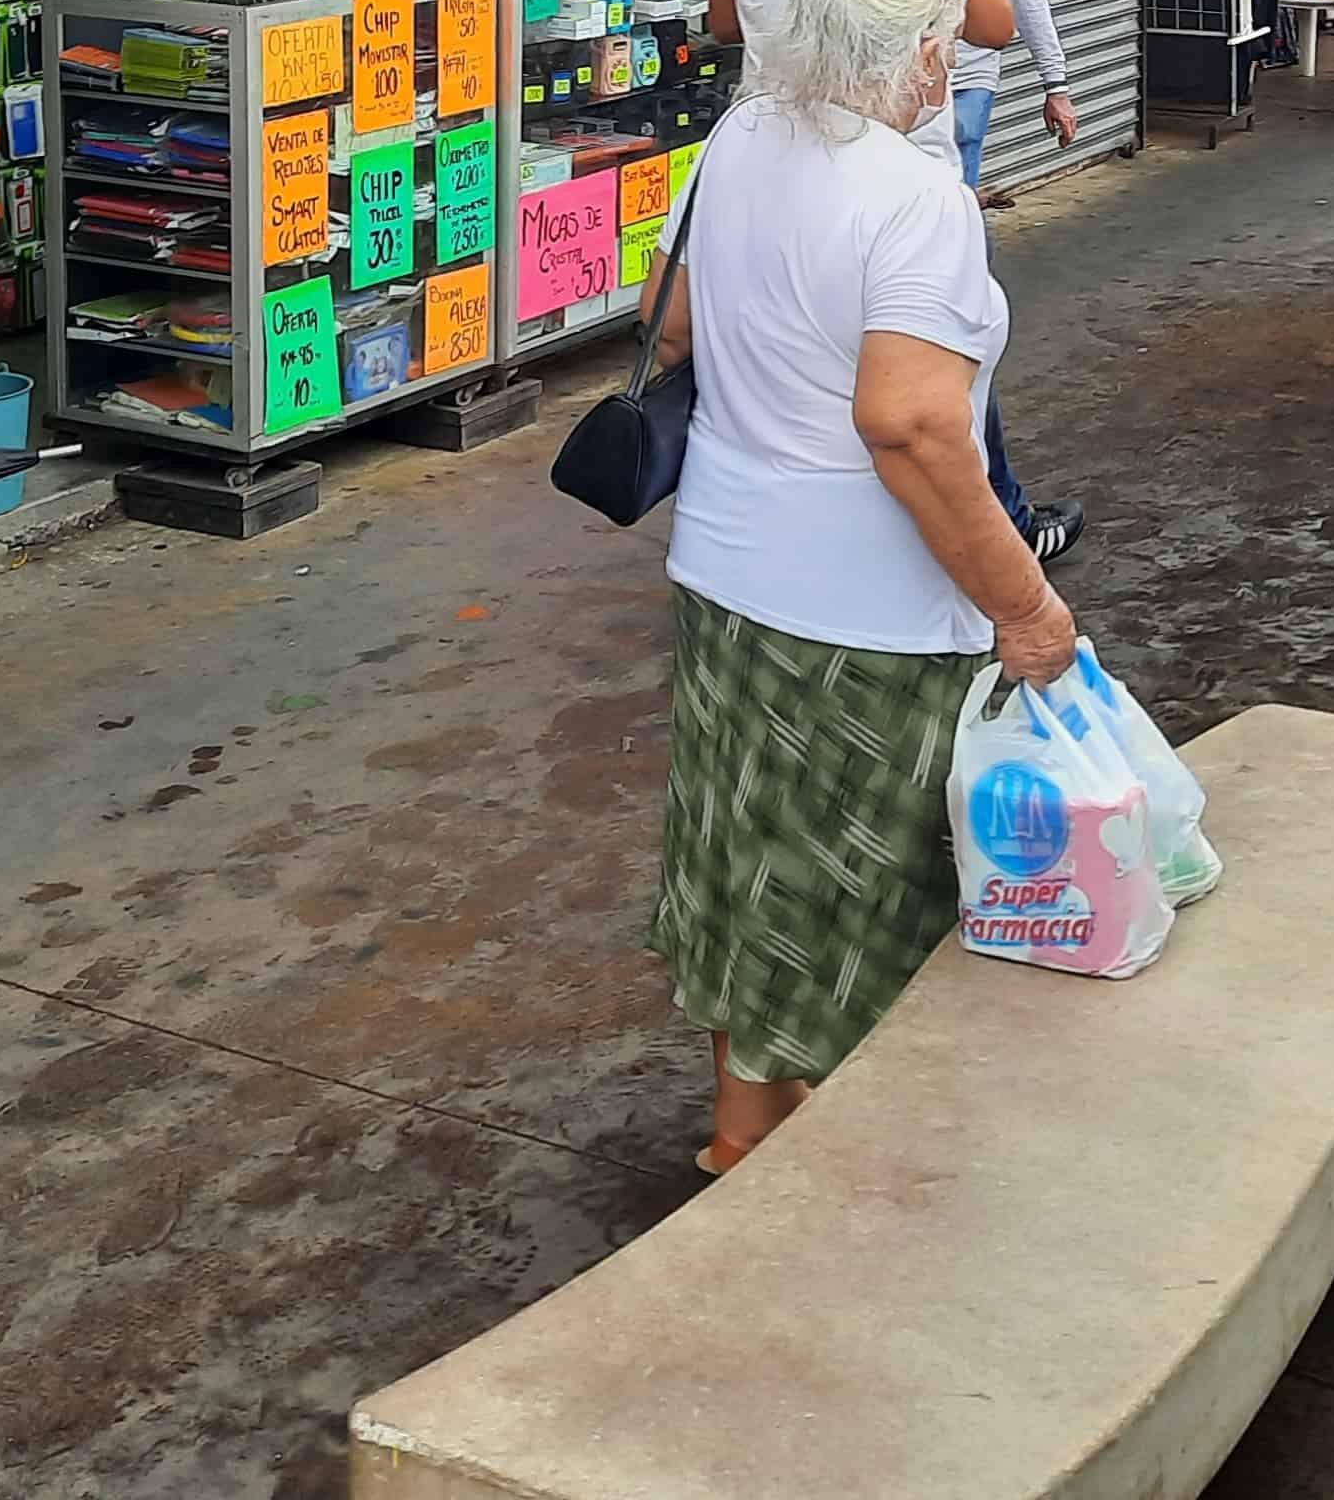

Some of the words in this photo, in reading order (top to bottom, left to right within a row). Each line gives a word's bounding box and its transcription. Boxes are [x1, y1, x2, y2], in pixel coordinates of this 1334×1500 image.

[364, 2, 401, 38] CHIP
[267, 23, 335, 58] OFERTA
[358, 43, 410, 67] MOVISTAR
[282, 52, 329, 79] KN-95
[267, 130, 308, 154] VENTA
[312, 127, 325, 145] DE
[273, 153, 325, 187] RELOJES
[360, 168, 403, 203] CHIP
[271, 195, 320, 227] SMART
[522, 200, 580, 250] MICAS
[584, 205, 603, 231] DE
[278, 221, 326, 254] WATCH
[539, 247, 585, 274] CRISTAL
[272, 302, 318, 337] OFERTA
[448, 295, 487, 326] ALEXA
[982, 877, 1068, 908] Super
